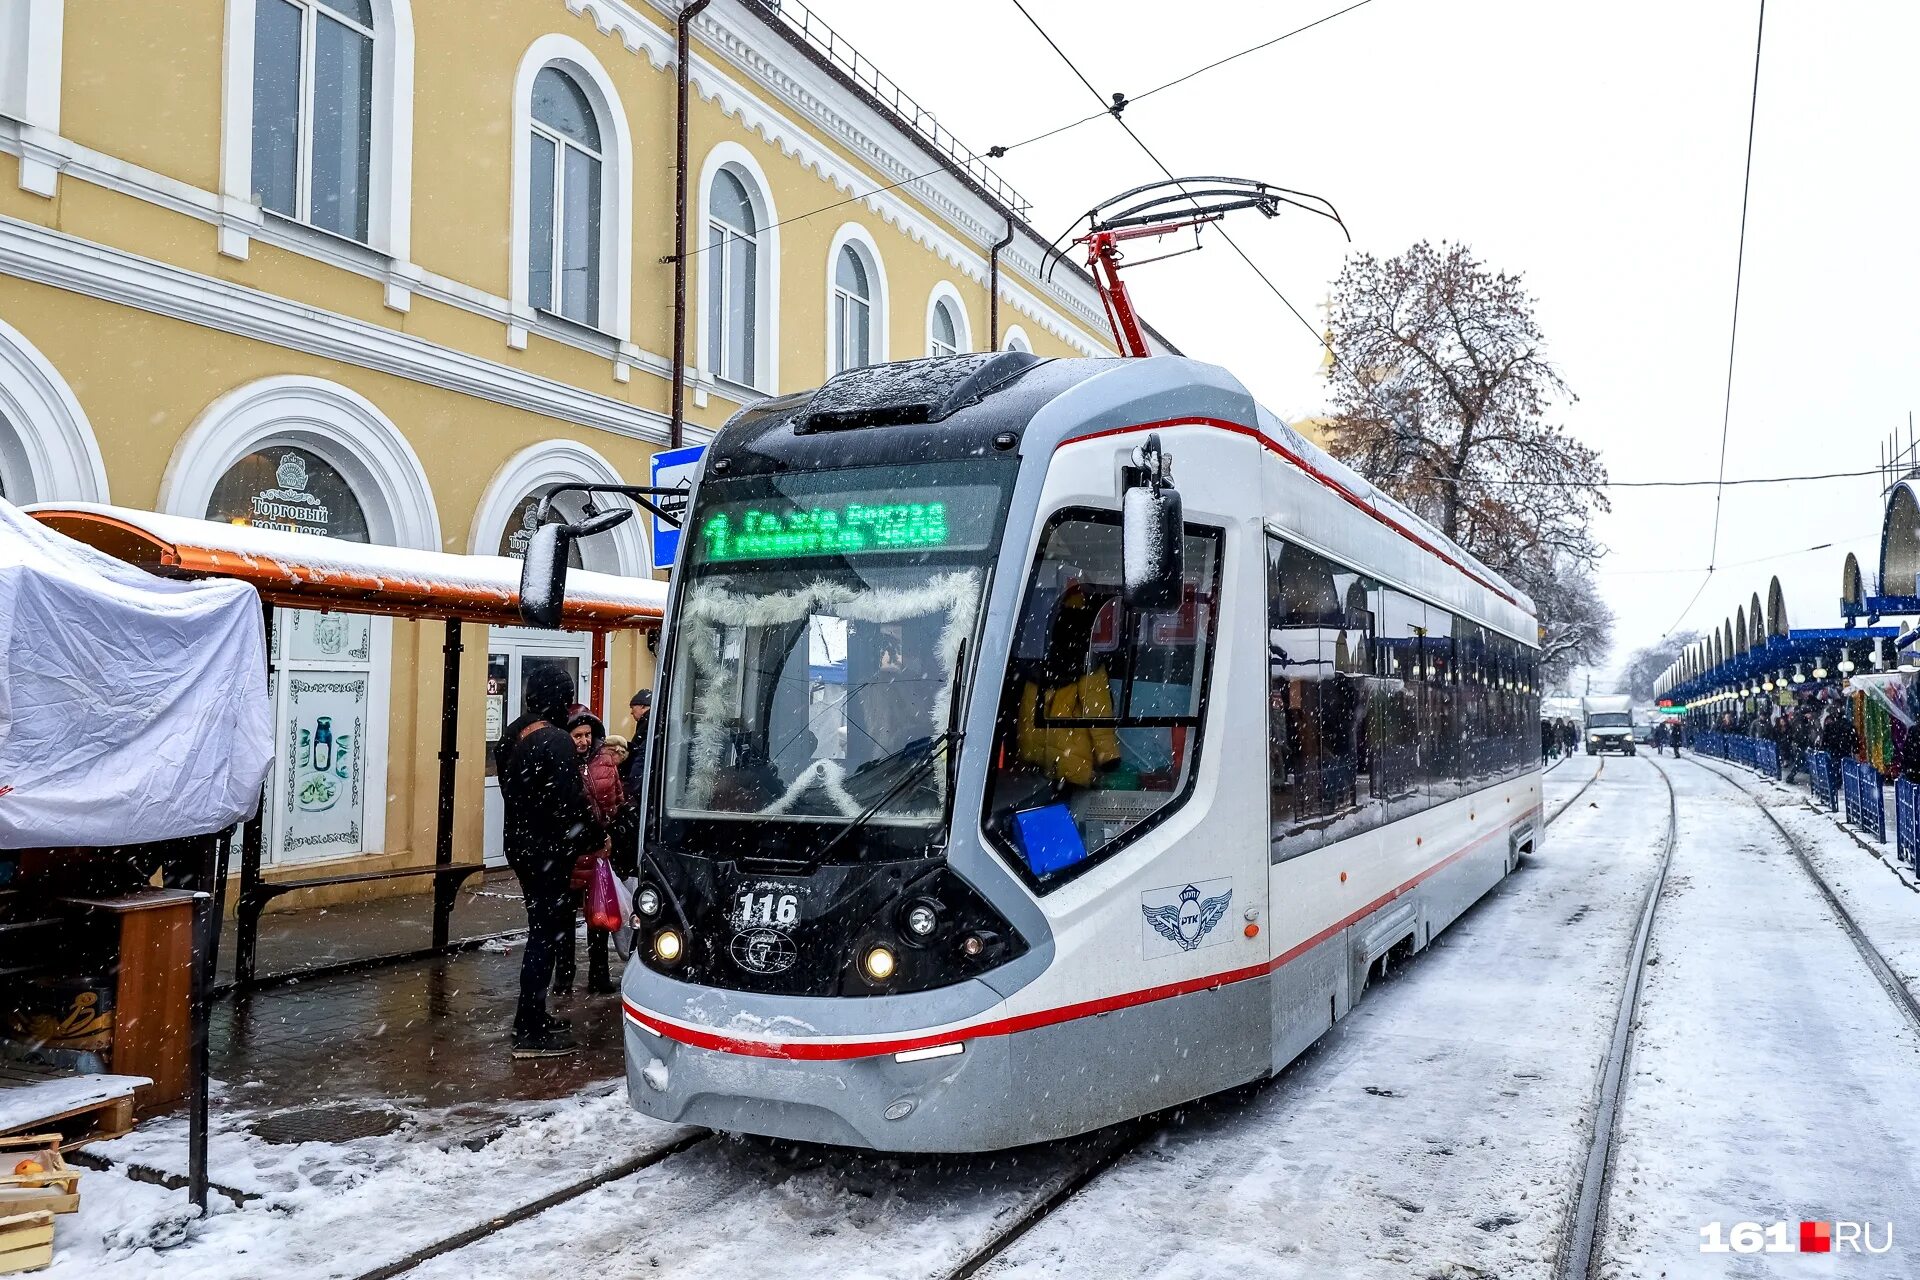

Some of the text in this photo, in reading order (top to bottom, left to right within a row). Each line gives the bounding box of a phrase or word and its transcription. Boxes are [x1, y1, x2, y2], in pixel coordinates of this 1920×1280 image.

[252, 497, 328, 523] Торговый
[702, 513, 727, 556] 1
[739, 892, 798, 925] 116
